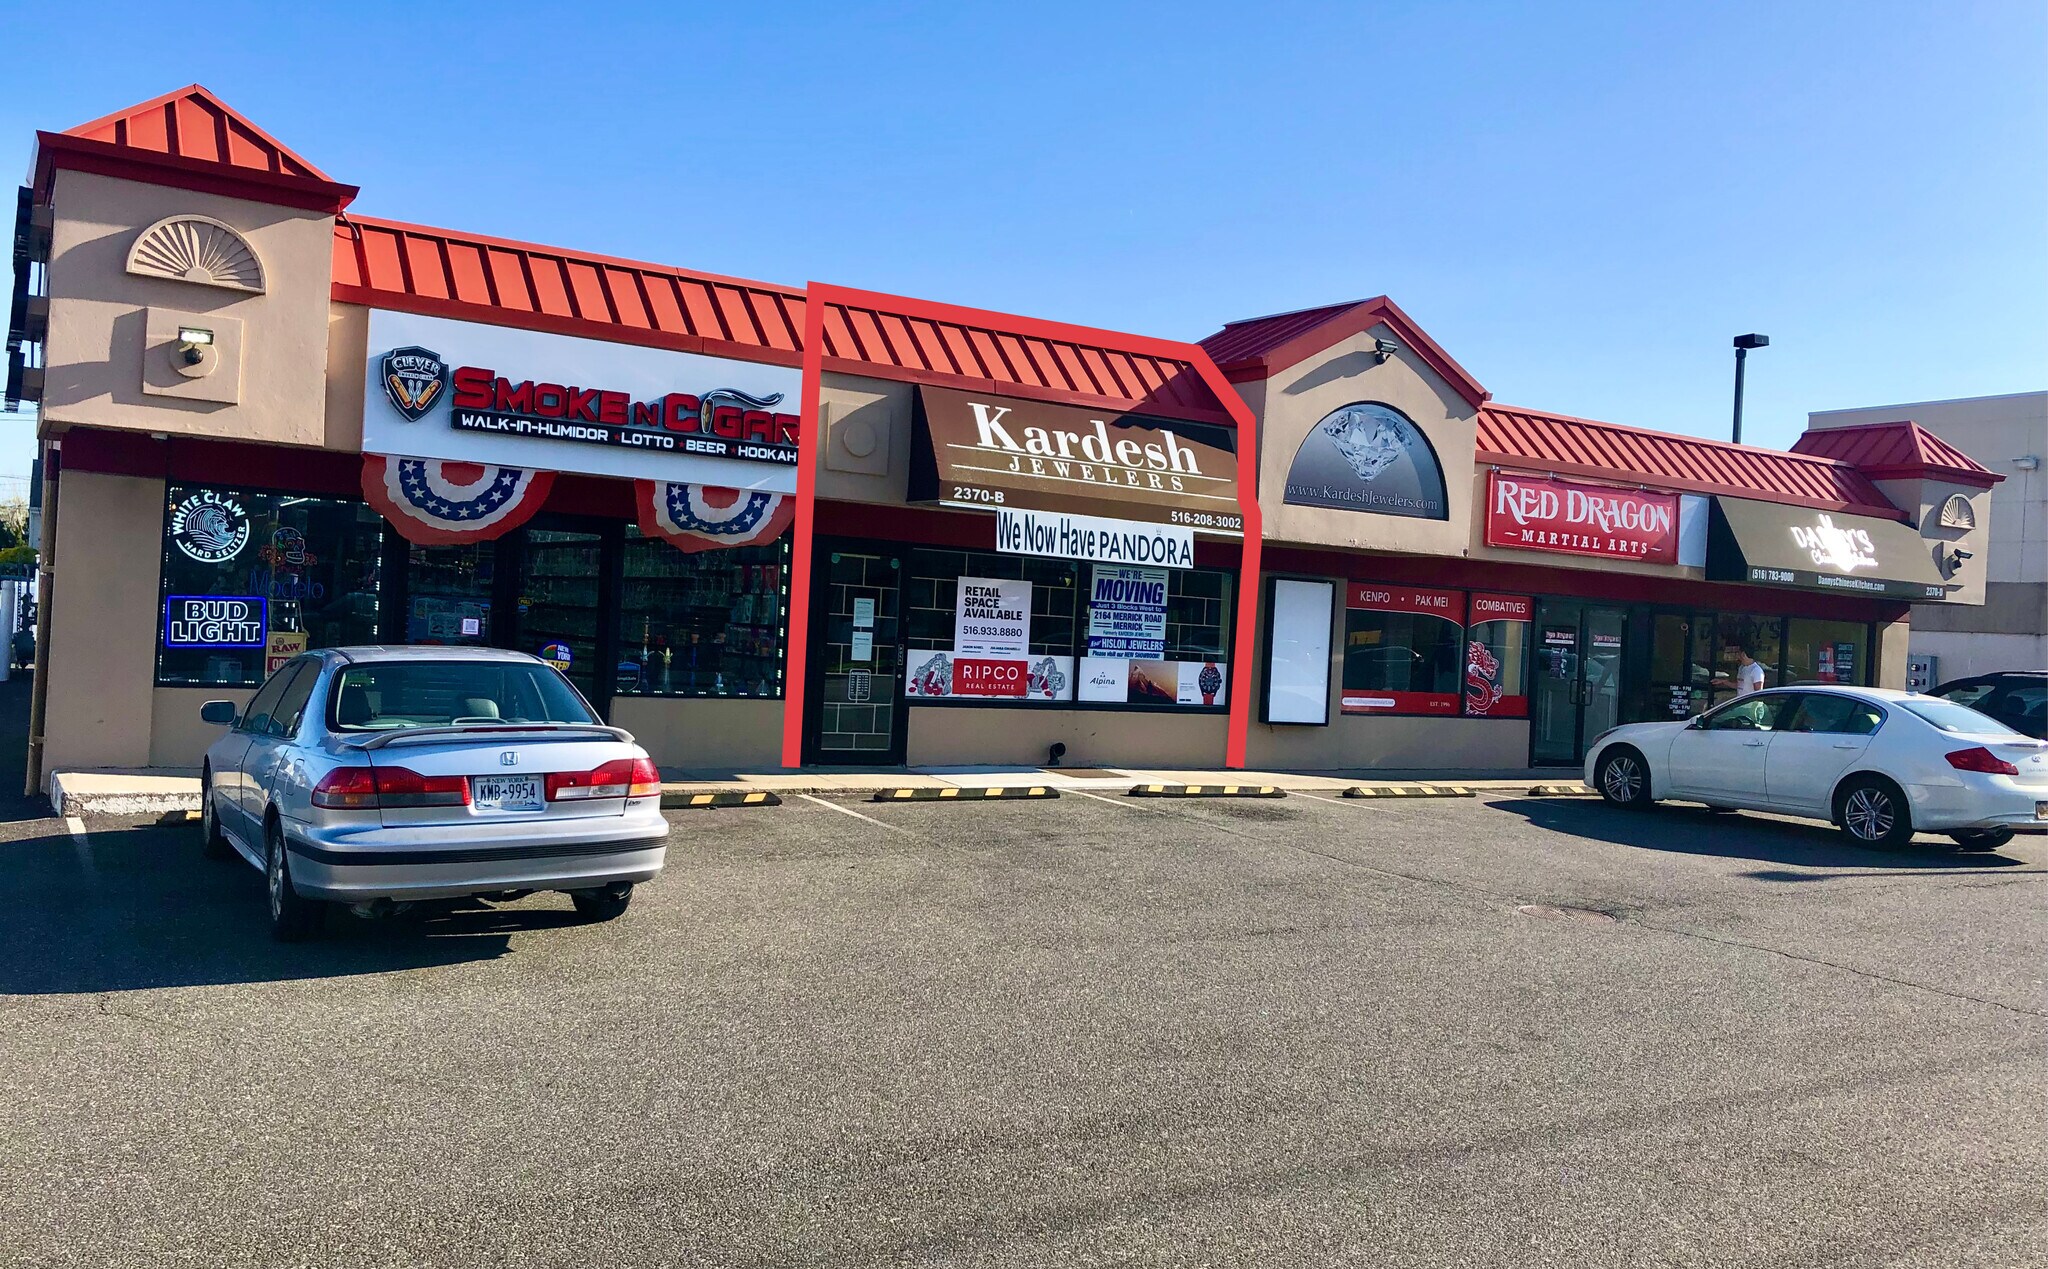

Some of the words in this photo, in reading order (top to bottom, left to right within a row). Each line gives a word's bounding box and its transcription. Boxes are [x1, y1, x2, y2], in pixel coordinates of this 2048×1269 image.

[393, 357, 439, 373] CLEVER
[452, 366, 630, 425] SMOKE
[634, 401, 659, 426] N
[461, 413, 608, 442] WALK-IN-HUMIDOR
[621, 431, 674, 449] LOTTO
[685, 439, 727, 455] BEER
[738, 445, 798, 463] HOOKAH
[967, 402, 1202, 475] Kardesh
[1008, 456, 1184, 491] JEWELERS
[953, 486, 1005, 503] 2370-B
[1287, 485, 1439, 511] www.KardeshJewelers.com
[172, 495, 202, 535] WHITE
[203, 492, 246, 517] CLAW
[1495, 480, 1560, 525] RED
[1566, 489, 1672, 536] DRAGON
[1170, 510, 1241, 529] 516-208-3002
[184, 541, 212, 558] HARD
[215, 526, 246, 558] SELTZER
[998, 511, 1021, 551] We
[1024, 513, 1057, 554] Now
[1060, 517, 1095, 558] Have
[1100, 530, 1193, 566] PANDORA
[1521, 529, 1601, 550] MARTIAL
[1607, 538, 1648, 554] ARTS
[1119, 569, 1143, 580] WE'RE
[1751, 568, 1767, 581] (516)
[249, 569, 324, 599] Modelo
[965, 586, 1001, 598] RETAIL
[1095, 578, 1165, 604] MOVING
[964, 597, 1000, 608] SPACE
[1360, 590, 1391, 603] KENPO
[1415, 594, 1432, 607] PAK
[1433, 596, 1449, 608] MEI
[184, 600, 249, 621] BUD
[963, 608, 1023, 621] AVAILABLE
[1117, 603, 1138, 611] Blocks
[1476, 599, 1526, 614] COMBATIVES
[1094, 611, 1111, 620] 2164
[1113, 612, 1143, 622] MERRICK
[1144, 614, 1162, 623] ROAD
[171, 621, 260, 643] LIGHT
[963, 625, 1023, 637] 516.933.8880
[1113, 621, 1143, 631] MERRICK
[271, 643, 301, 653] RAW
[1102, 638, 1126, 649] HISLON
[1128, 640, 1164, 651] JEWELERS
[963, 665, 1019, 681] RIPCO
[1090, 677, 1116, 686] Alpina
[480, 784, 501, 801] KMB
[508, 783, 535, 799] 9954
